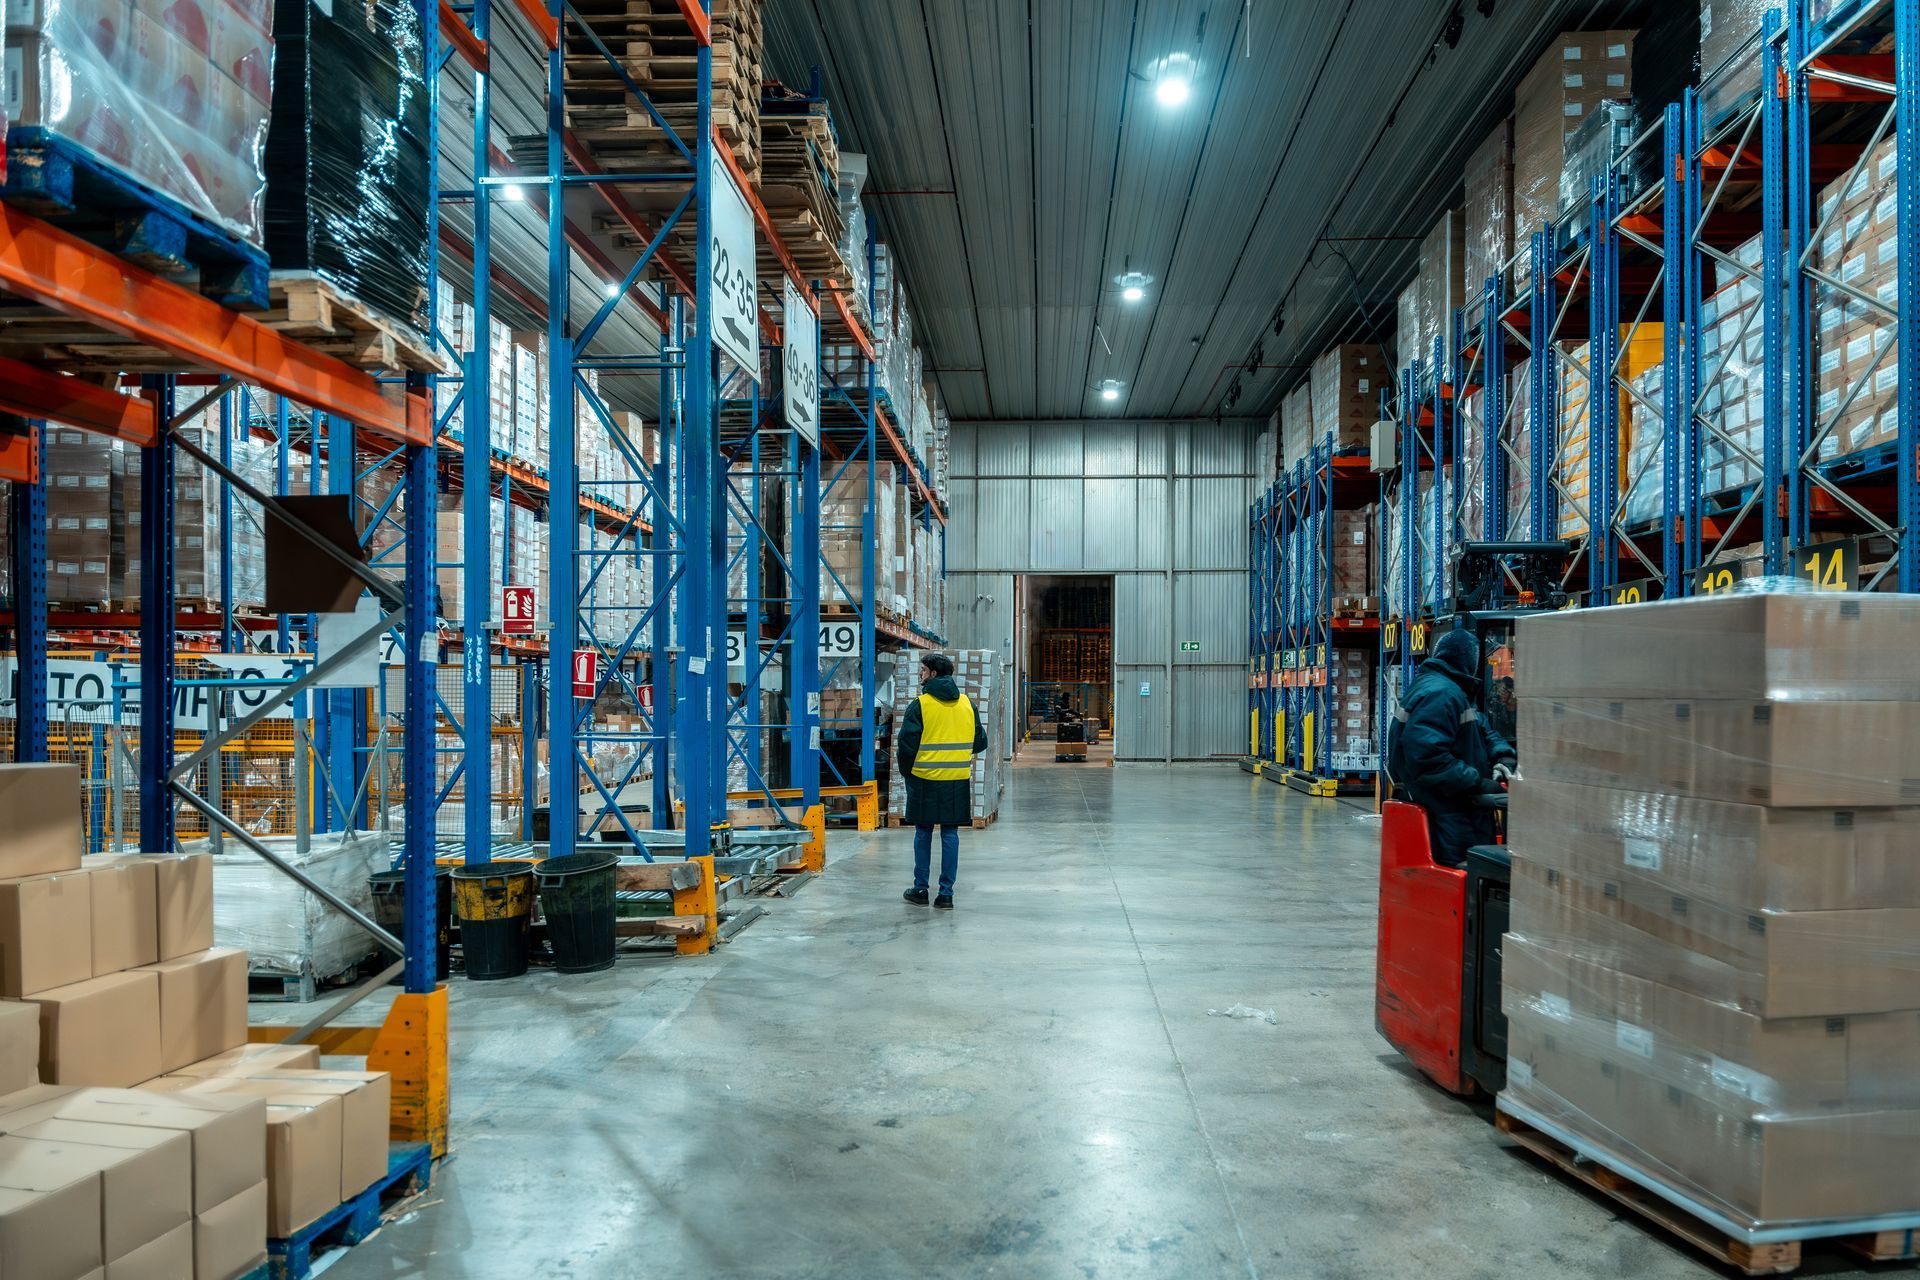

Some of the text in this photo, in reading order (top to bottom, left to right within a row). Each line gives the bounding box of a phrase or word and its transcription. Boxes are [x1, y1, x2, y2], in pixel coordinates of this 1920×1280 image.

[713, 236, 755, 327] 22-35
[787, 343, 815, 404] 49-36
[1804, 548, 1848, 593] 14
[819, 626, 855, 652] 49
[1384, 623, 1396, 648] 07
[1411, 623, 1424, 651] 08
